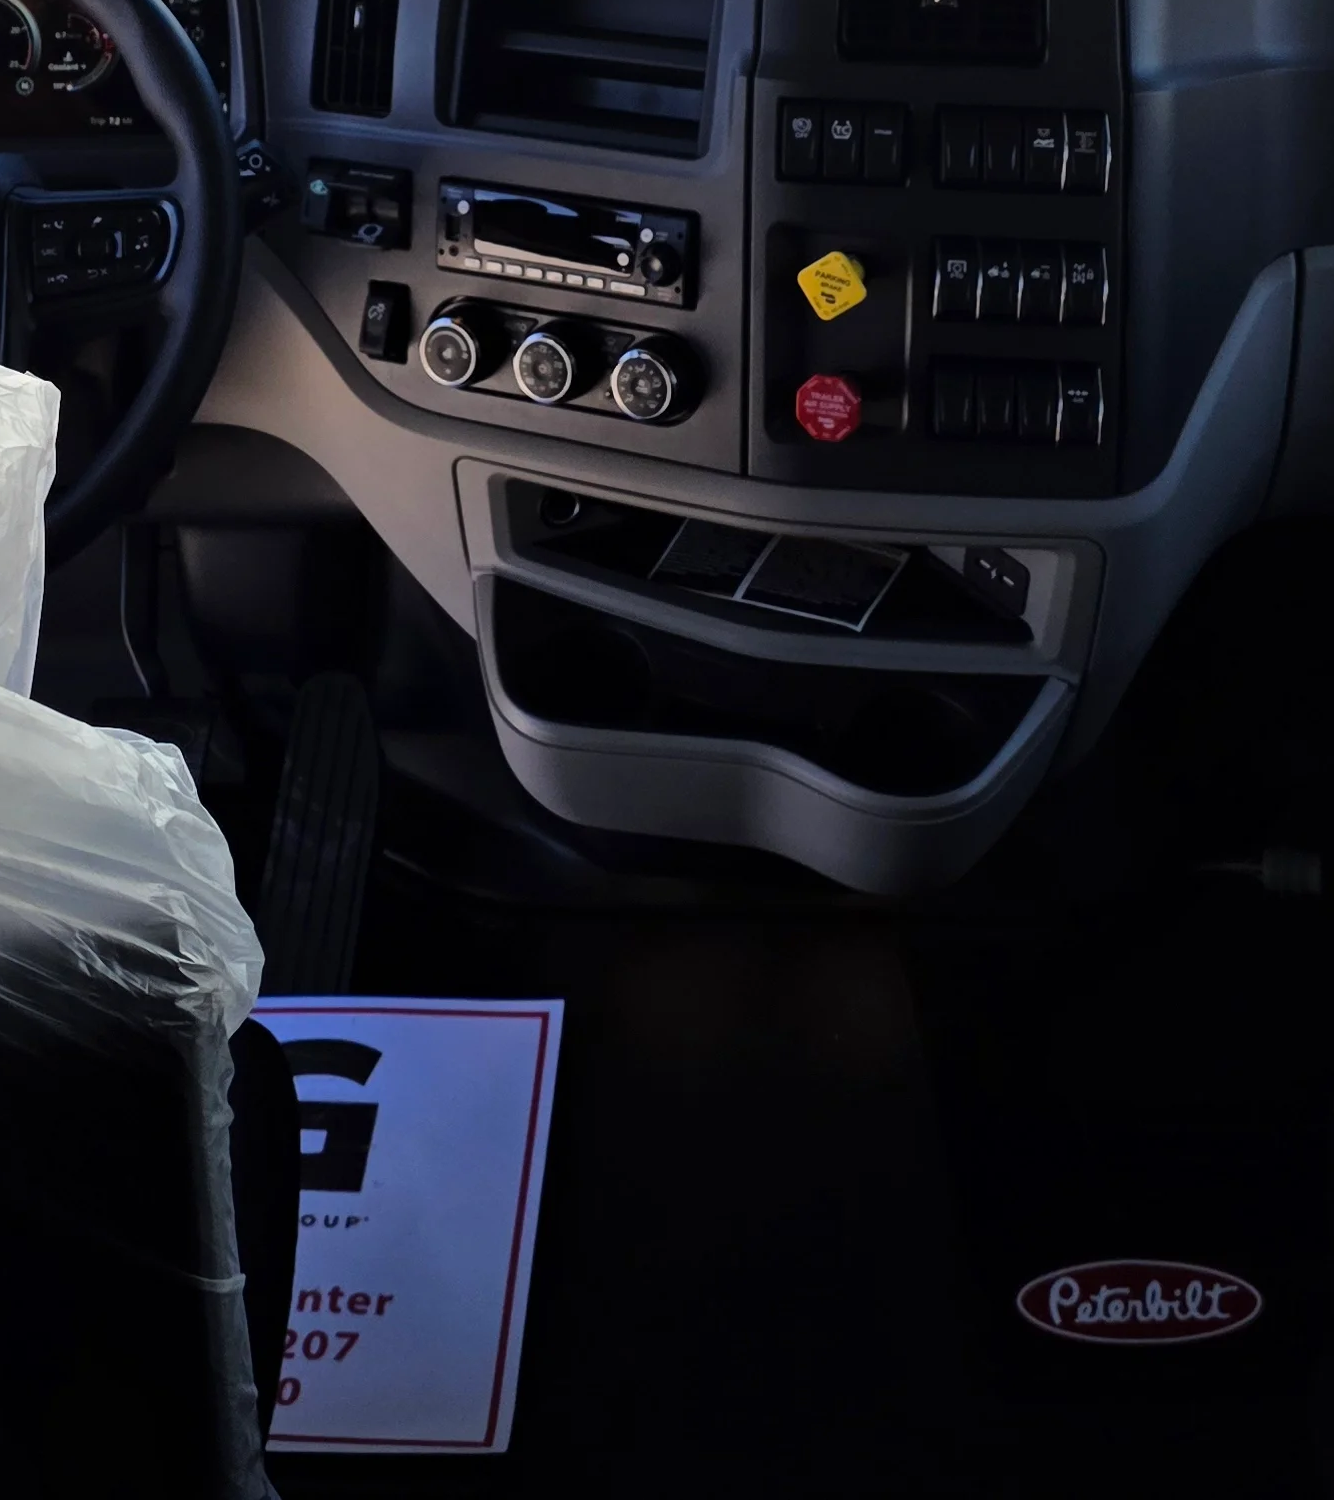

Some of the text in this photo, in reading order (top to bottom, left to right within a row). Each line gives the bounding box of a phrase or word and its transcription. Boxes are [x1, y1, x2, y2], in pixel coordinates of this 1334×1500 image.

[300, 1214, 361, 1229] OUP
[296, 1285, 395, 1317] nter
[1049, 1276, 1238, 1326] Peterbilt
[282, 1329, 360, 1362] 207
